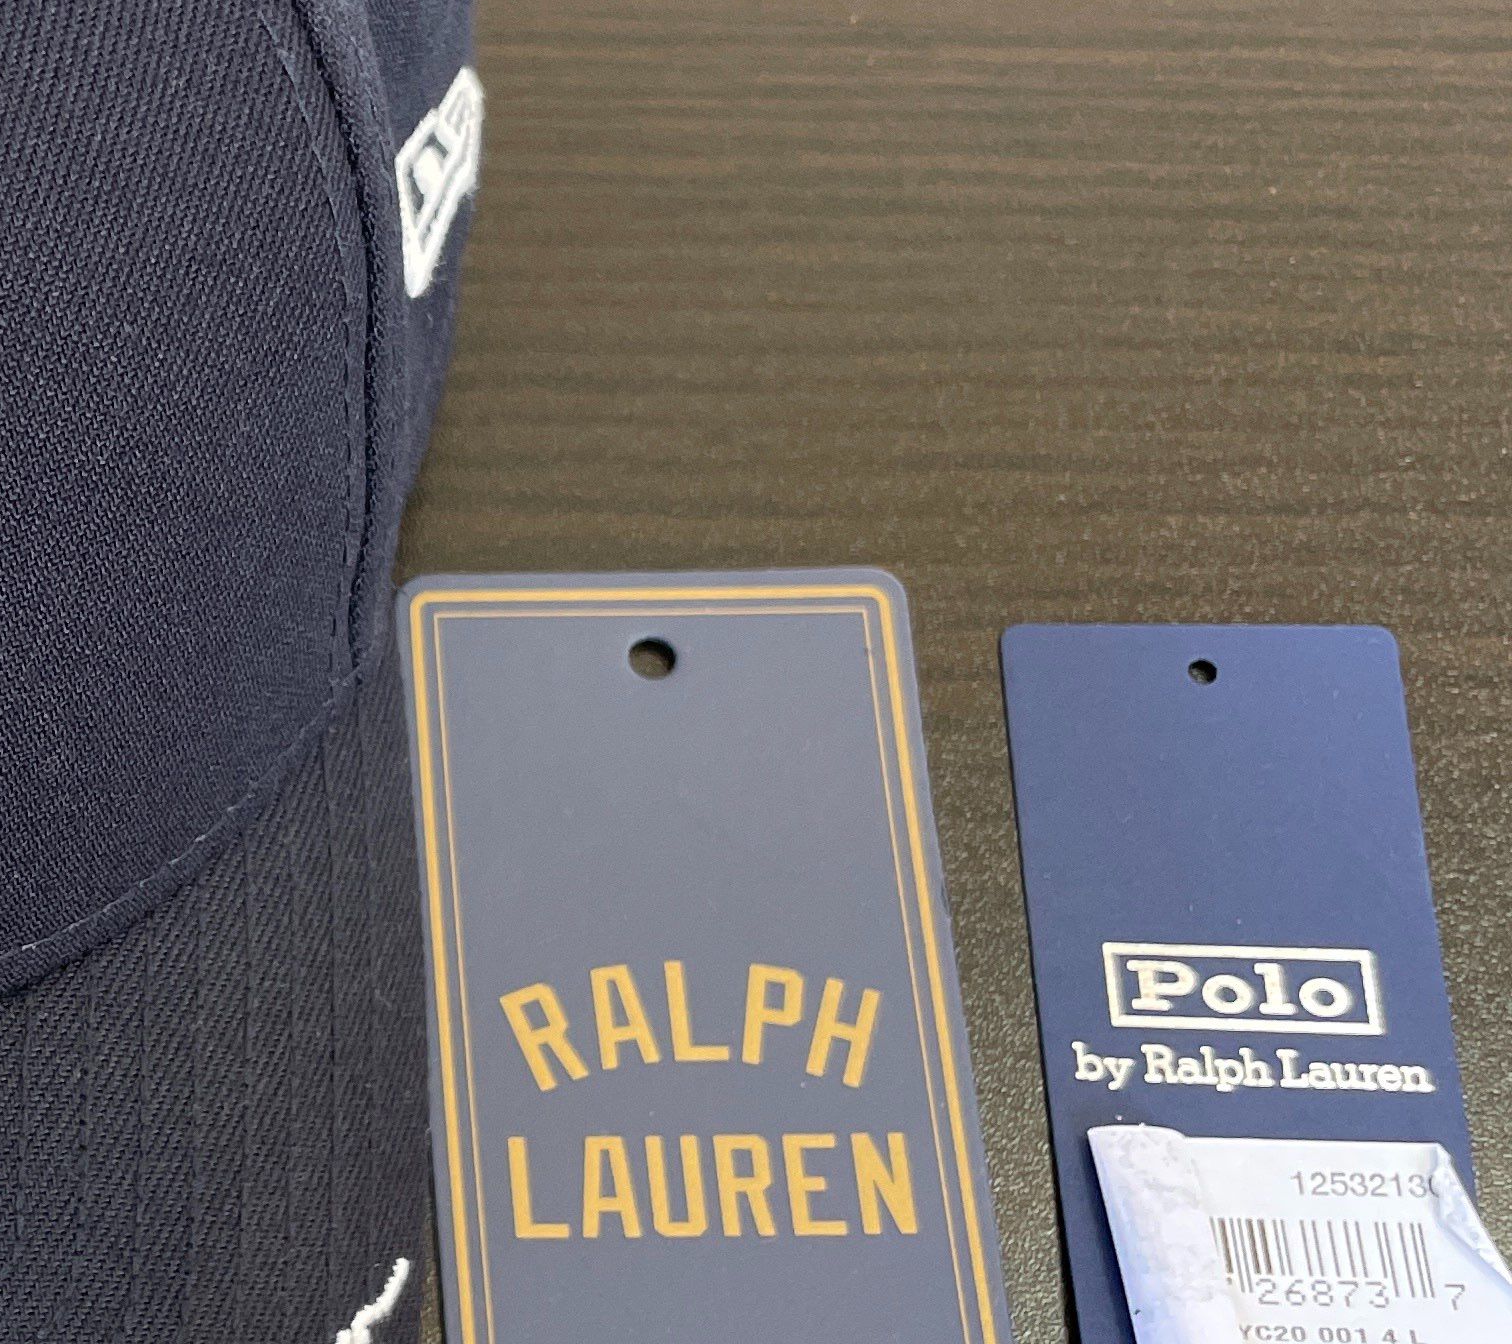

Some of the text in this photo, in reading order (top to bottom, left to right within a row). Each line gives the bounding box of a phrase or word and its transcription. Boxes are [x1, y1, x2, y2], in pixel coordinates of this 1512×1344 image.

[1125, 959, 1354, 1018] Polo
[499, 959, 881, 1092] RALPH
[1071, 1041, 1437, 1094] by Ralph Lauren
[507, 1131, 919, 1241] LAUREN
[1382, 1329, 1397, 1344] 4
